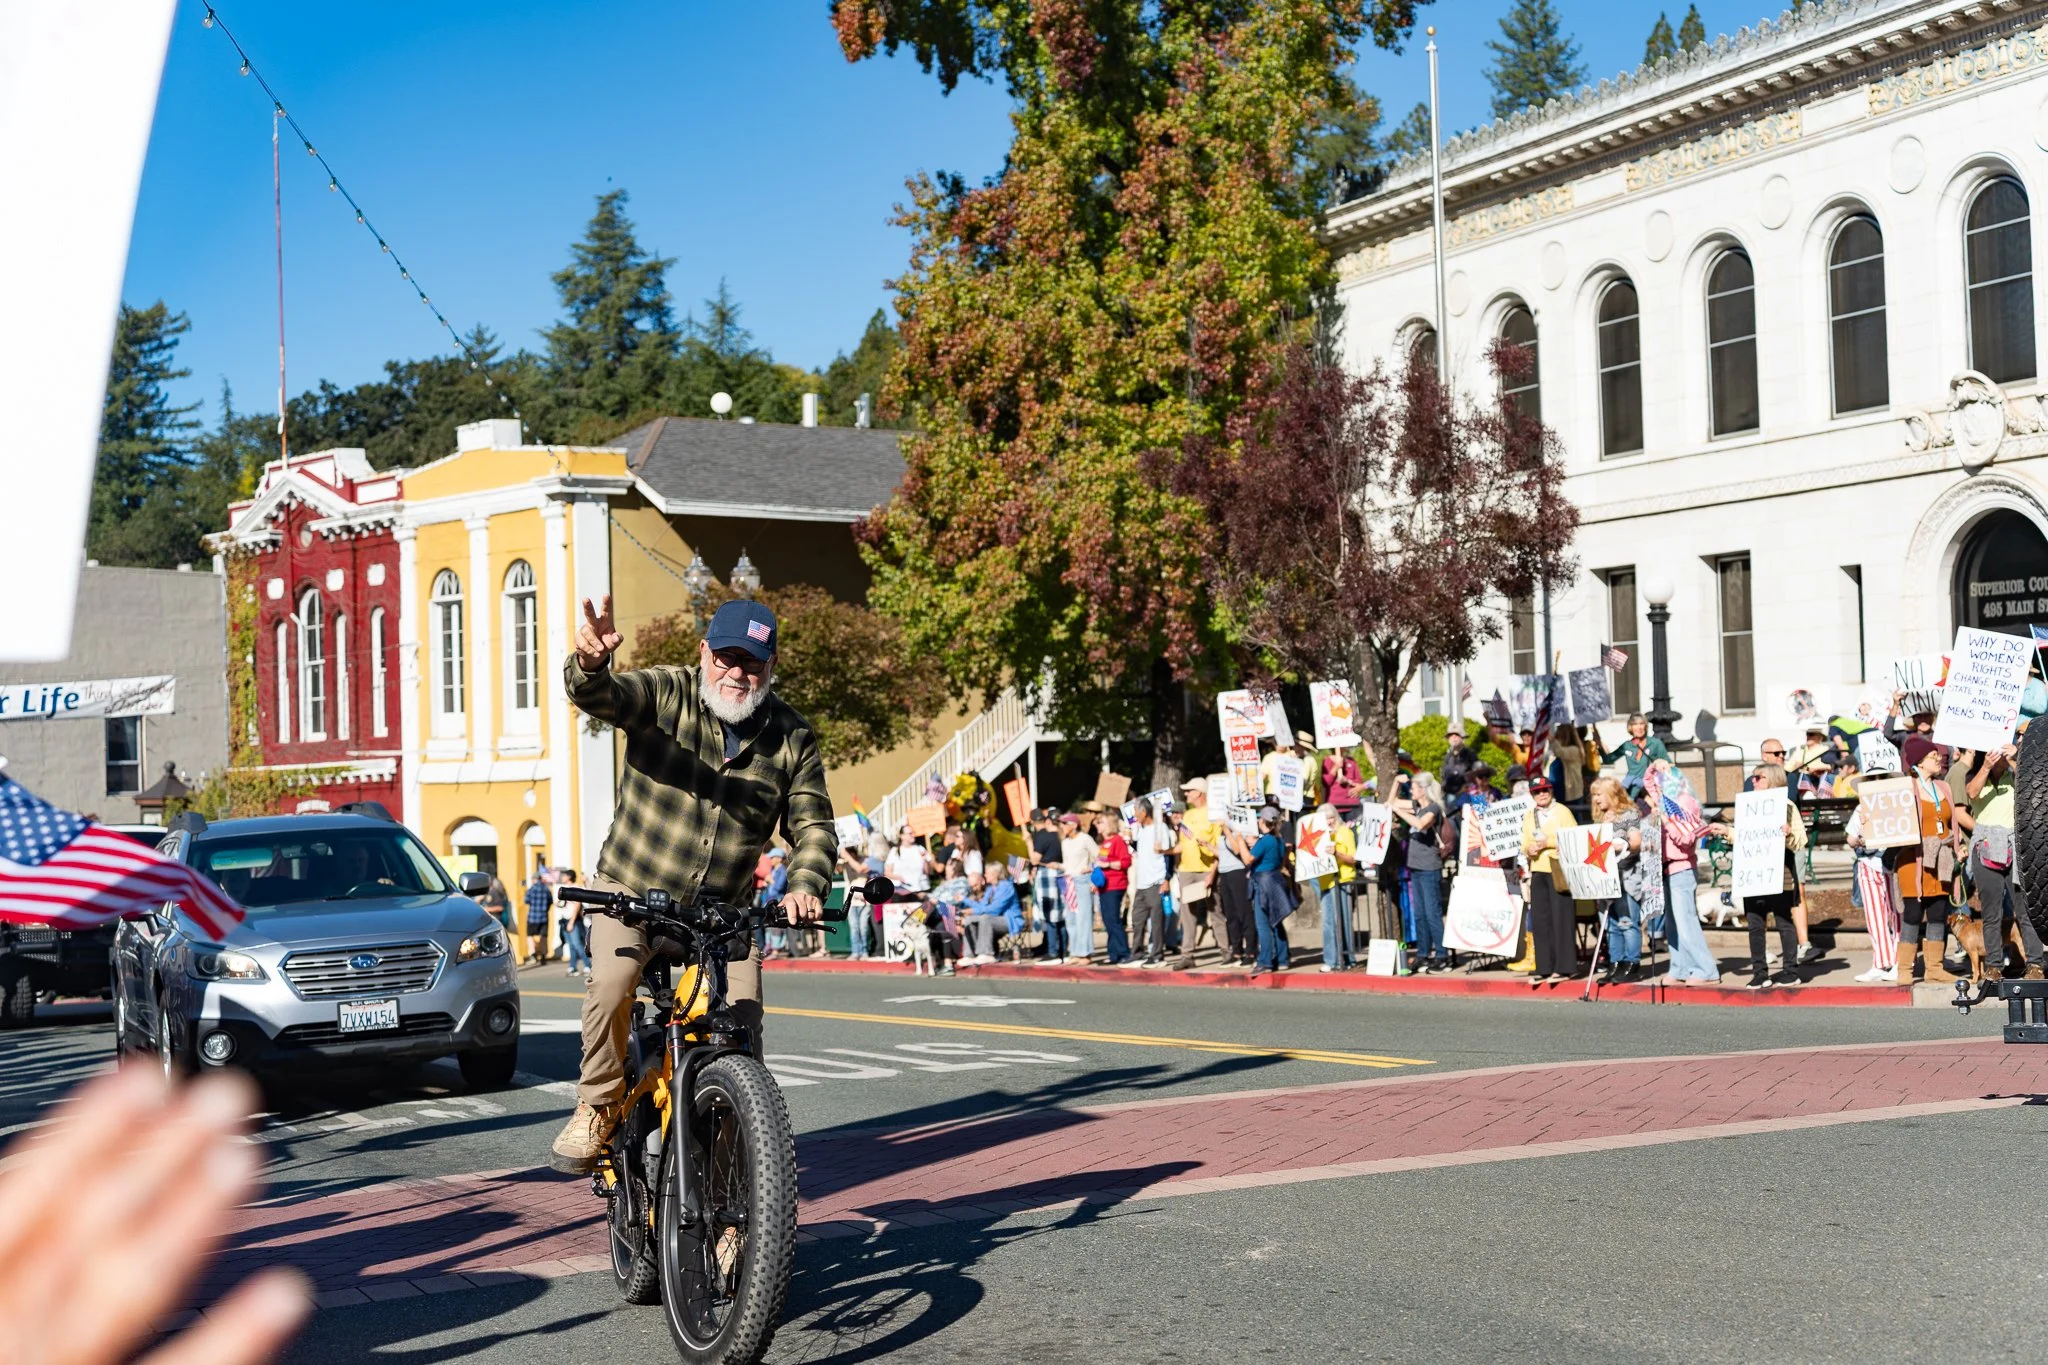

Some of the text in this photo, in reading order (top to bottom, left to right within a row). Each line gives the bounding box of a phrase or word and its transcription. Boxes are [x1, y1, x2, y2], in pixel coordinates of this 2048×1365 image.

[1970, 579, 2026, 597] SUPERIOR
[1983, 602, 2003, 618] 495
[2006, 600, 2035, 616] MAIN
[1969, 633, 2025, 652] WHY DO
[1970, 649, 2026, 667] WOMEN'S
[1894, 659, 1924, 690] NO
[1971, 662, 2012, 678] RIGHTS
[1954, 672, 2020, 692] CHANGE FROM
[23, 686, 80, 719] Life
[1898, 688, 1945, 718] KING
[1949, 685, 1973, 696] STATE
[1993, 692, 2017, 704] STATE
[1970, 697, 1991, 707] AND
[1745, 798, 1775, 817] NO
[1862, 788, 1915, 811] VETO
[1486, 806, 1511, 818] WHERE
[1511, 802, 1528, 812] WAS
[1485, 829, 1519, 842] NATIONAL
[1872, 815, 1912, 838] EGO
[1742, 842, 1772, 859] WAY
[341, 1010, 395, 1028] 7VXW154
